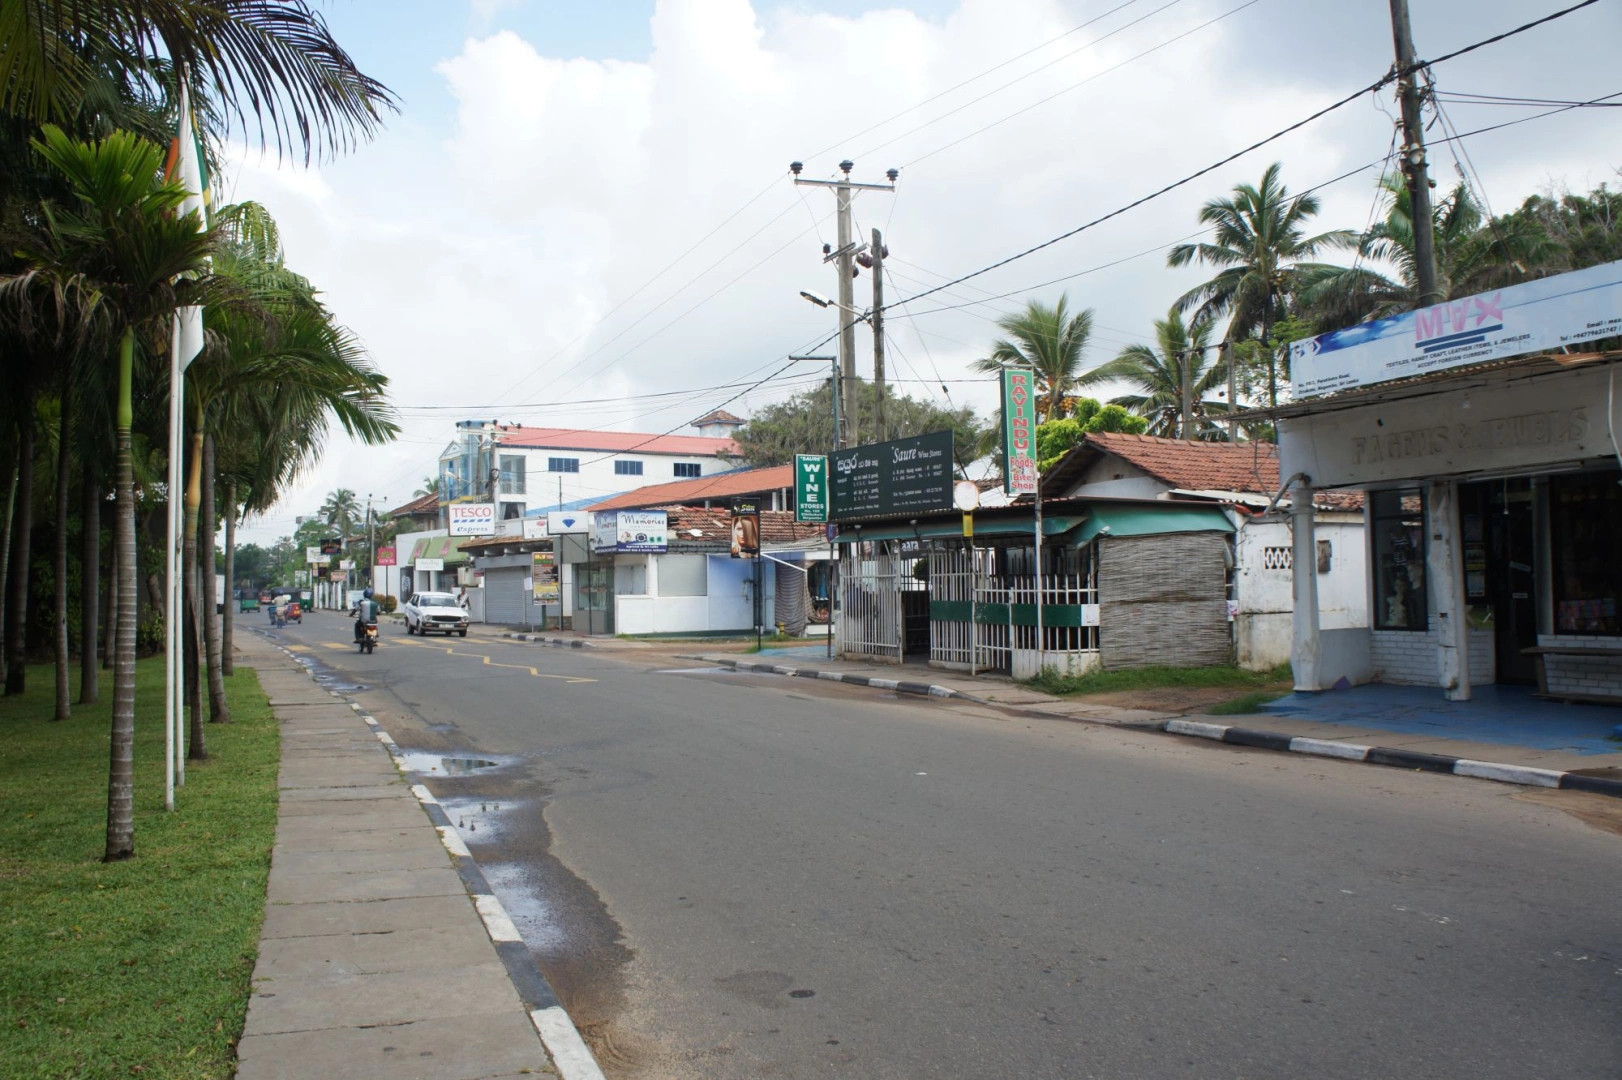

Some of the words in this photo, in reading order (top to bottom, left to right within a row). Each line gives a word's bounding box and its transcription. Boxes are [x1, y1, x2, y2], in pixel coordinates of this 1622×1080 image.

[1462, 349, 1493, 359] CURRENCY
[1012, 375, 1029, 449] RAVINDU
[803, 463, 820, 503] WINE
[1011, 482, 1034, 490] Shop
[452, 507, 491, 518] TESCO
[621, 514, 665, 525] Memories
